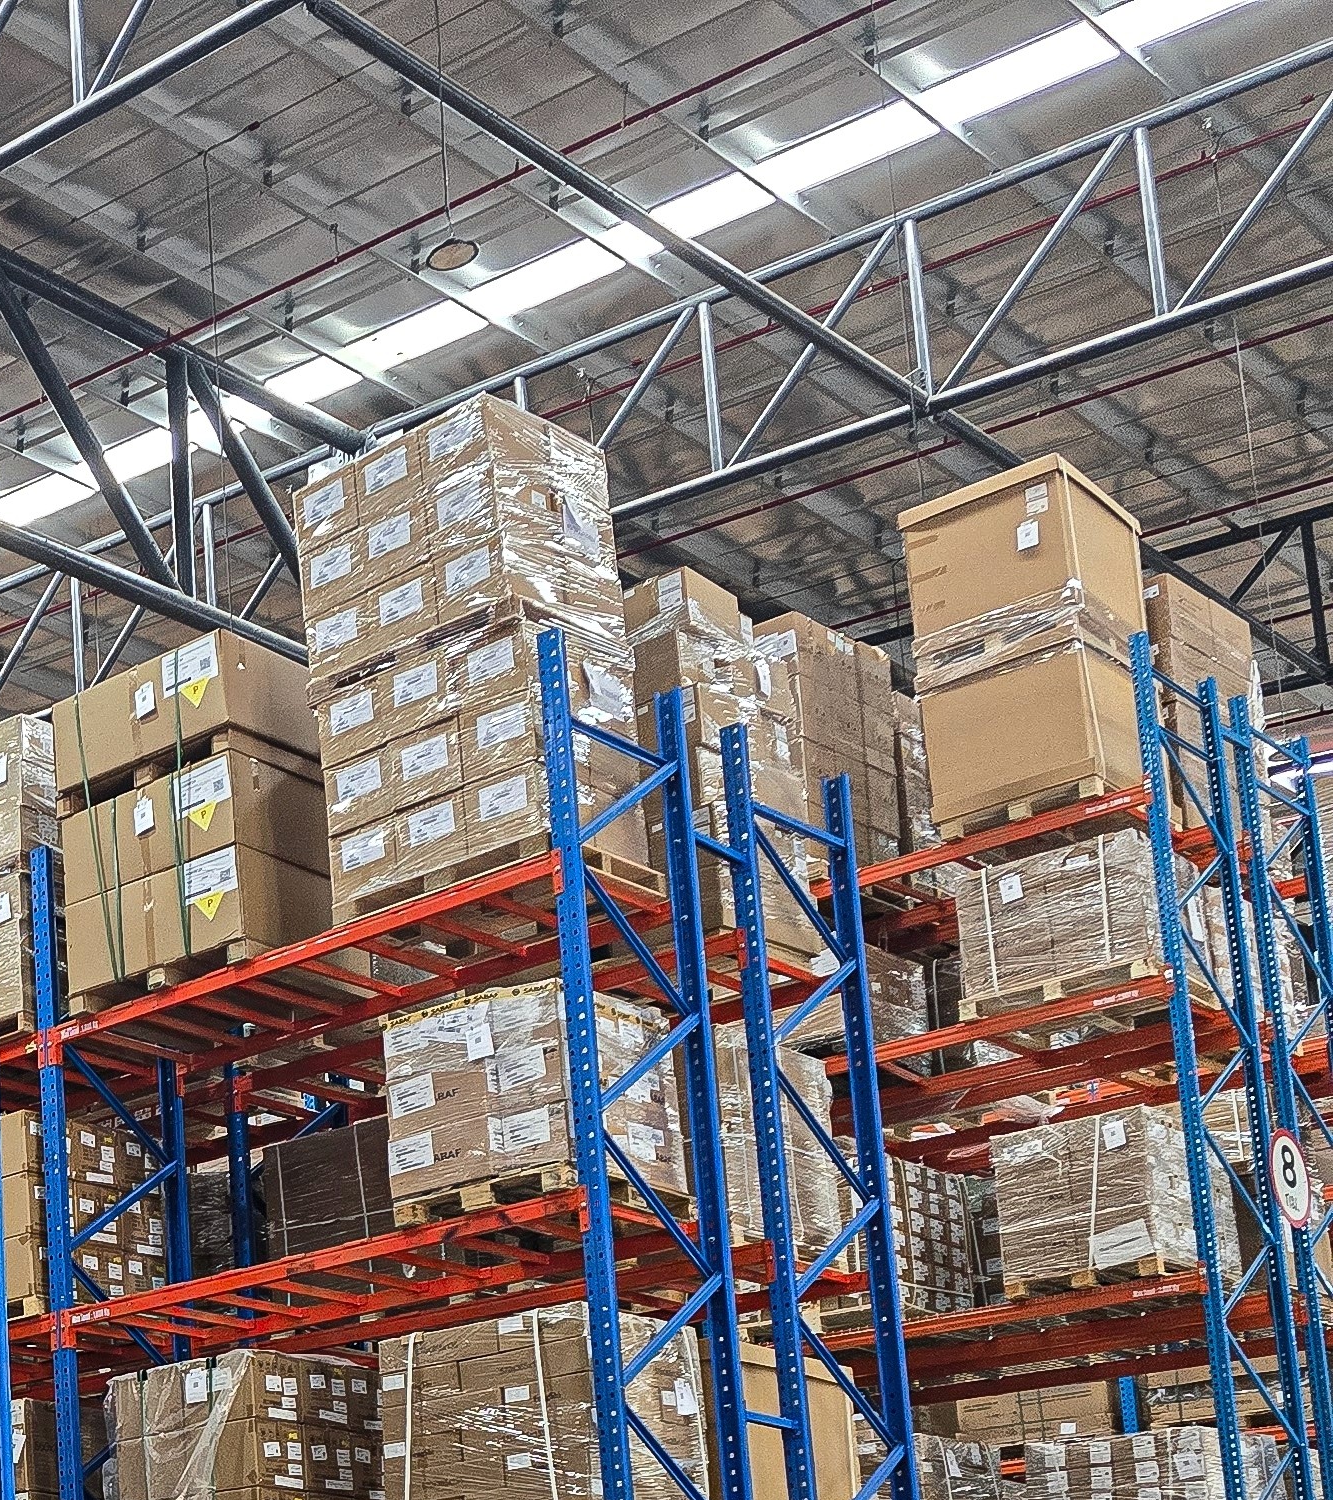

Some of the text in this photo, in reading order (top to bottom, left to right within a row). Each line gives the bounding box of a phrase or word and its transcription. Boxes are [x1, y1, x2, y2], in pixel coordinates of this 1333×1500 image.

[436, 1088, 460, 1101] BAF
[434, 1148, 461, 1162] ABAF
[1280, 1144, 1297, 1188] 8
